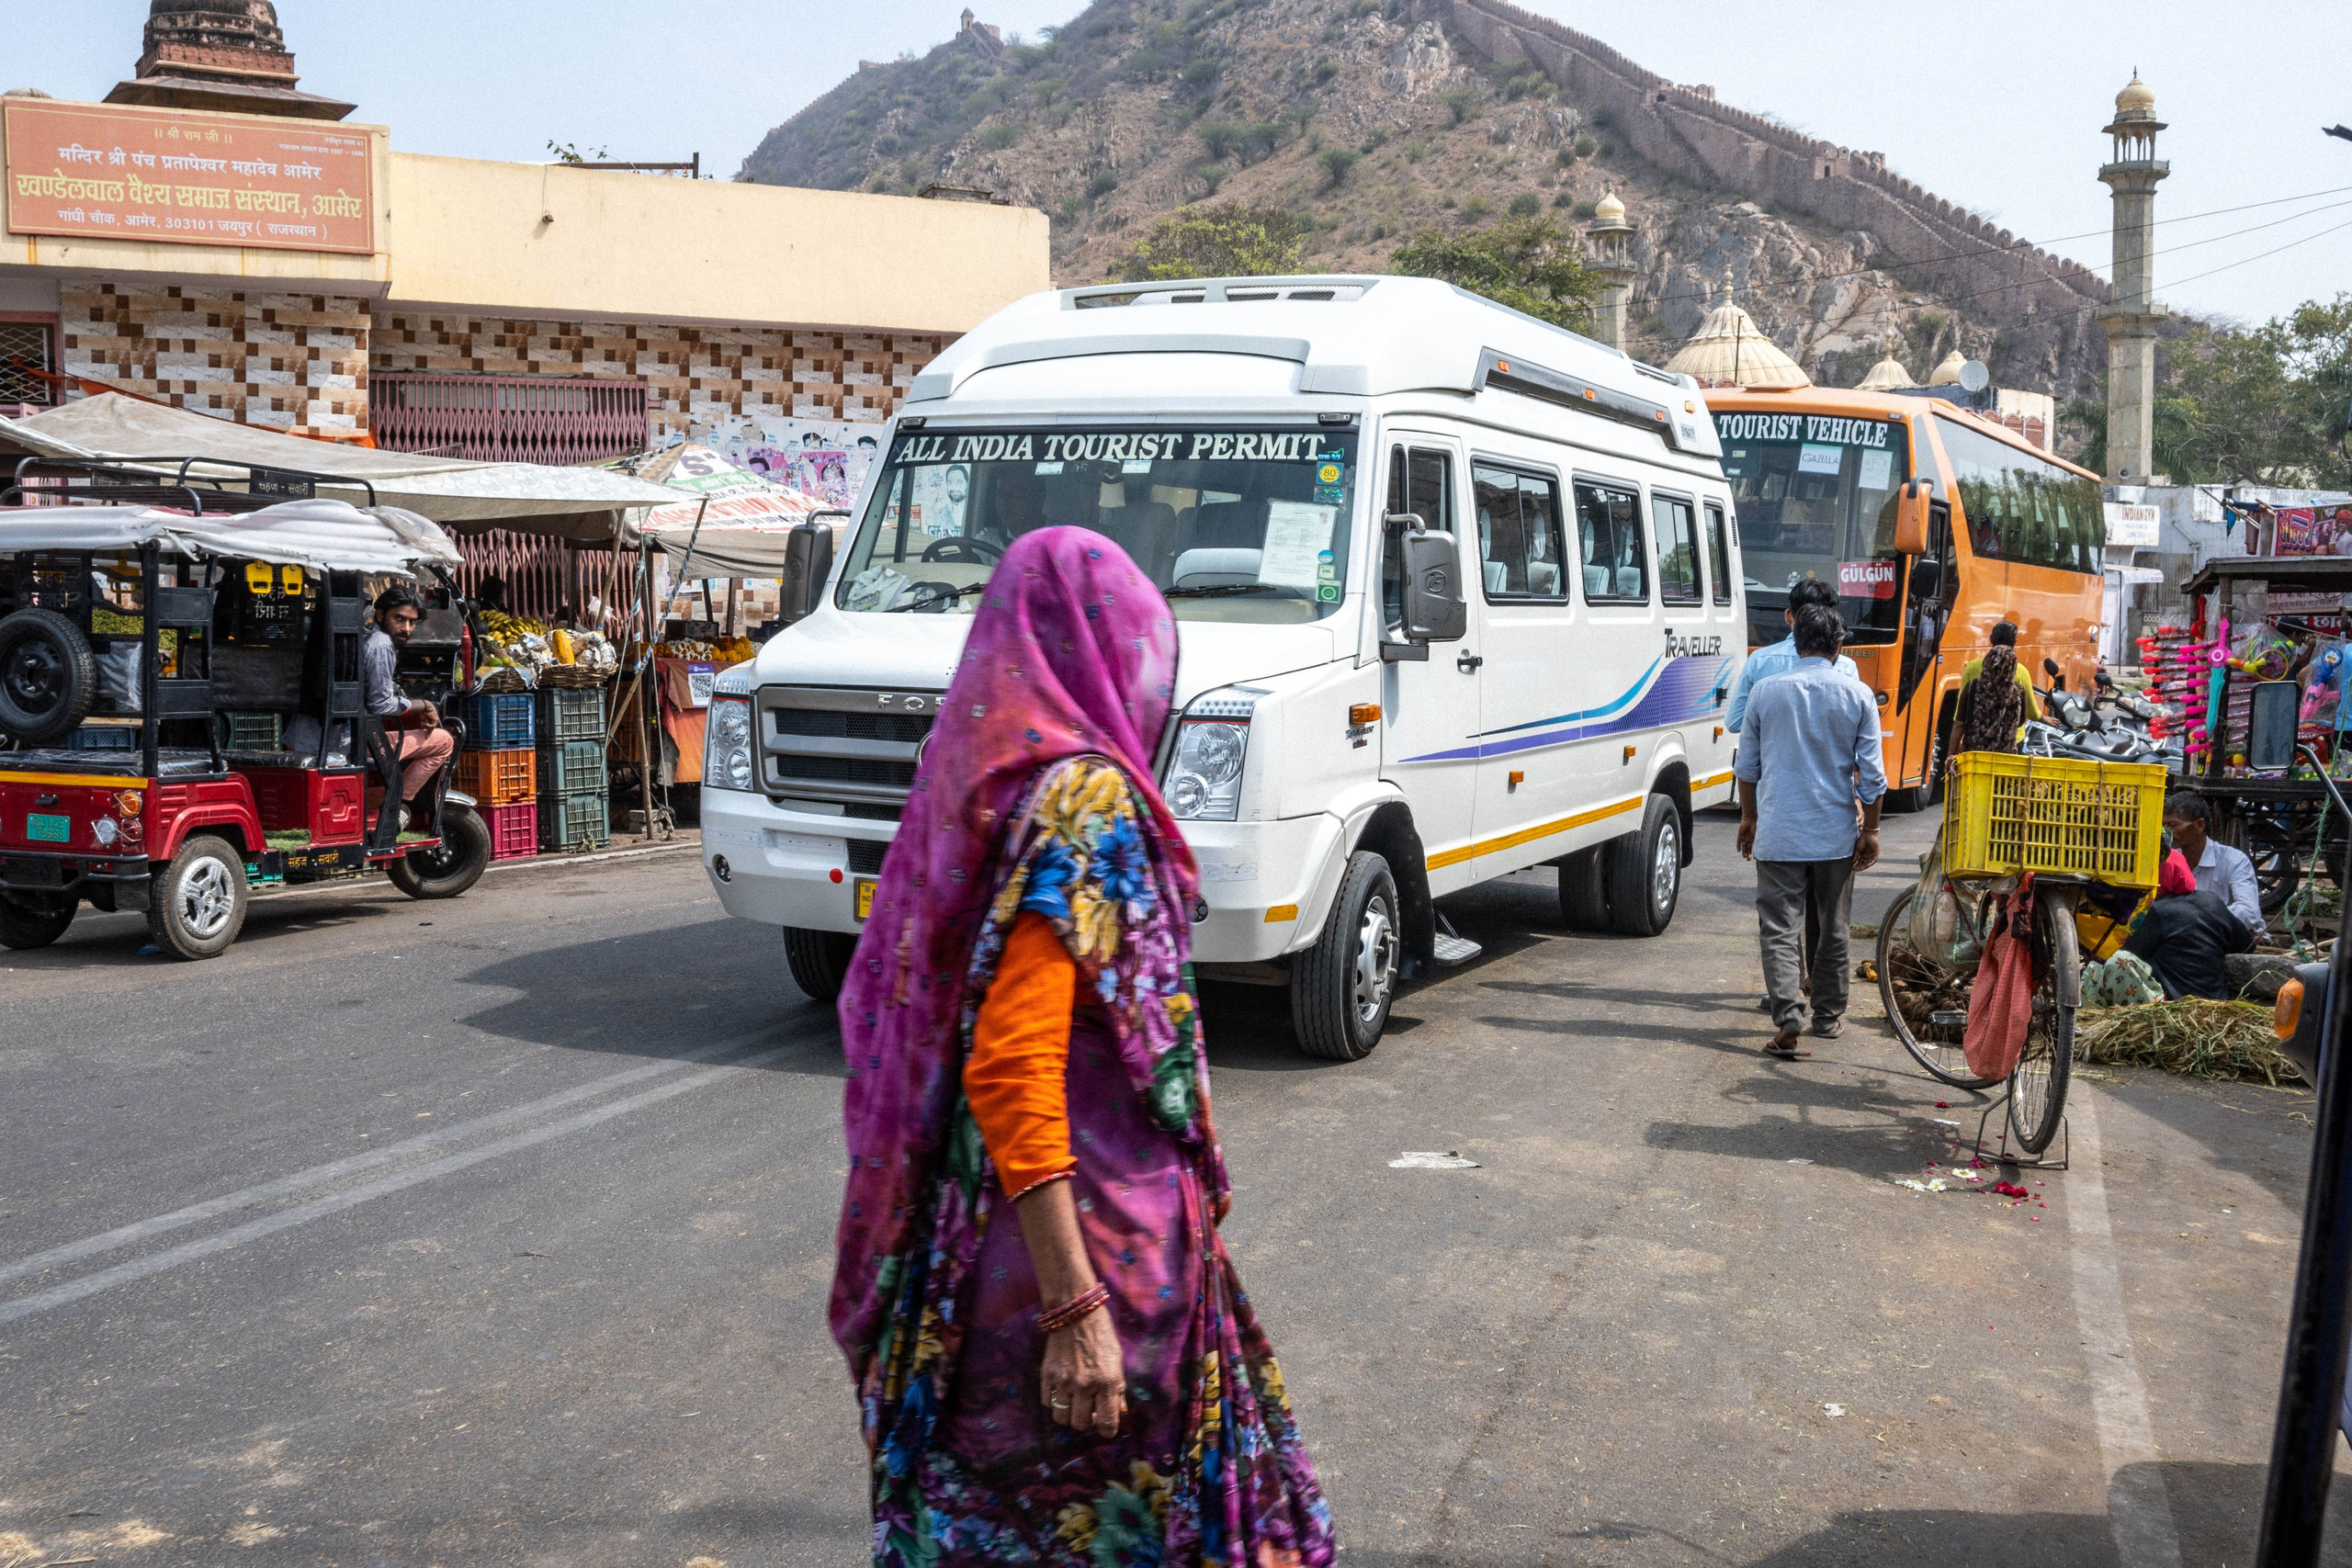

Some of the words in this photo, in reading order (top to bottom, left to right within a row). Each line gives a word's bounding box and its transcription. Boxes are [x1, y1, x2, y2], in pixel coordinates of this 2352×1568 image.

[183, 130, 201, 141] राम
[58, 142, 103, 164] मन्दिर
[107, 146, 126, 166] श्री
[131, 150, 156, 168] पंच
[161, 152, 227, 175] प्रतापेश्वर
[231, 157, 278, 176] महादेव
[283, 161, 322, 179] आमेर
[16, 167, 126, 203] खण्डेलवाल
[126, 173, 172, 205] वैश्य
[175, 185, 231, 209] समाज
[312, 187, 363, 220] आमेर
[57, 207, 85, 224] गांधी
[164, 217, 214, 231] 303101
[217, 220, 254, 236] जयपुर
[266, 222, 316, 237] राजस्थान
[1720, 414, 1803, 440] TOURIST
[1806, 416, 1889, 448] VEHICLE
[895, 434, 946, 464] ALL
[951, 434, 1034, 461] INDIA
[1044, 434, 1182, 461] TOURIST
[1189, 433, 1327, 460] PERMIT
[1801, 453, 1839, 465] GAZELLA
[1323, 468, 1337, 478] 80
[2121, 507, 2144, 522] INDIAN
[1840, 562, 1894, 583] GÜLGÜN
[2143, 615, 2161, 623] GOOD
[1664, 628, 1722, 659] TRAVELLER
[1840, 648, 1875, 658] UTLEJ
[288, 856, 308, 868] सहज
[318, 850, 339, 864] सवारी
